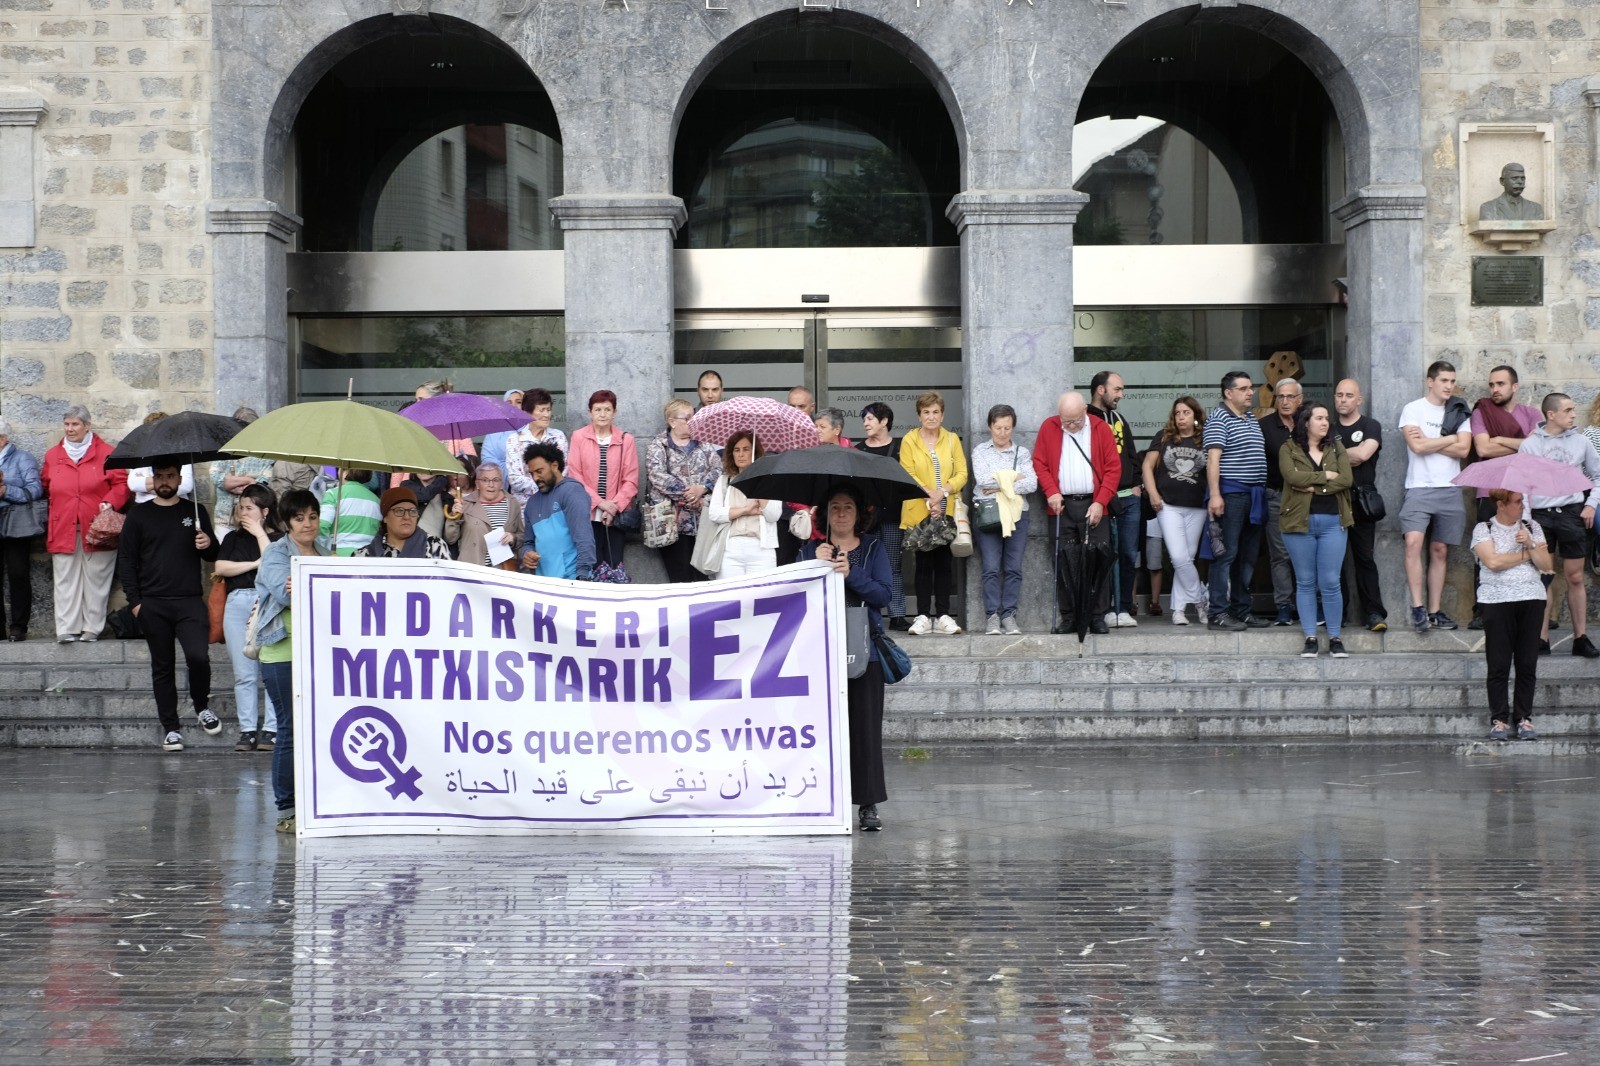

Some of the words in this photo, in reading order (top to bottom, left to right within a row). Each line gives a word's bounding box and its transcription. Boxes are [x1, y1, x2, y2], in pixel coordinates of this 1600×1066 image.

[836, 394, 894, 403] AYUNTAMIENTO
[895, 393, 906, 402] DE
[330, 591, 669, 650] INDARKERI
[689, 591, 810, 702] EZ
[332, 647, 672, 703] MATXISTARIK
[444, 720, 513, 755] Nos
[524, 728, 711, 763] queremos
[721, 718, 817, 750] vivas
[445, 769, 517, 801] الحياة
[532, 768, 568, 803] قيد
[579, 768, 634, 806] على
[719, 759, 749, 801] أن
[763, 766, 818, 798] نريد
